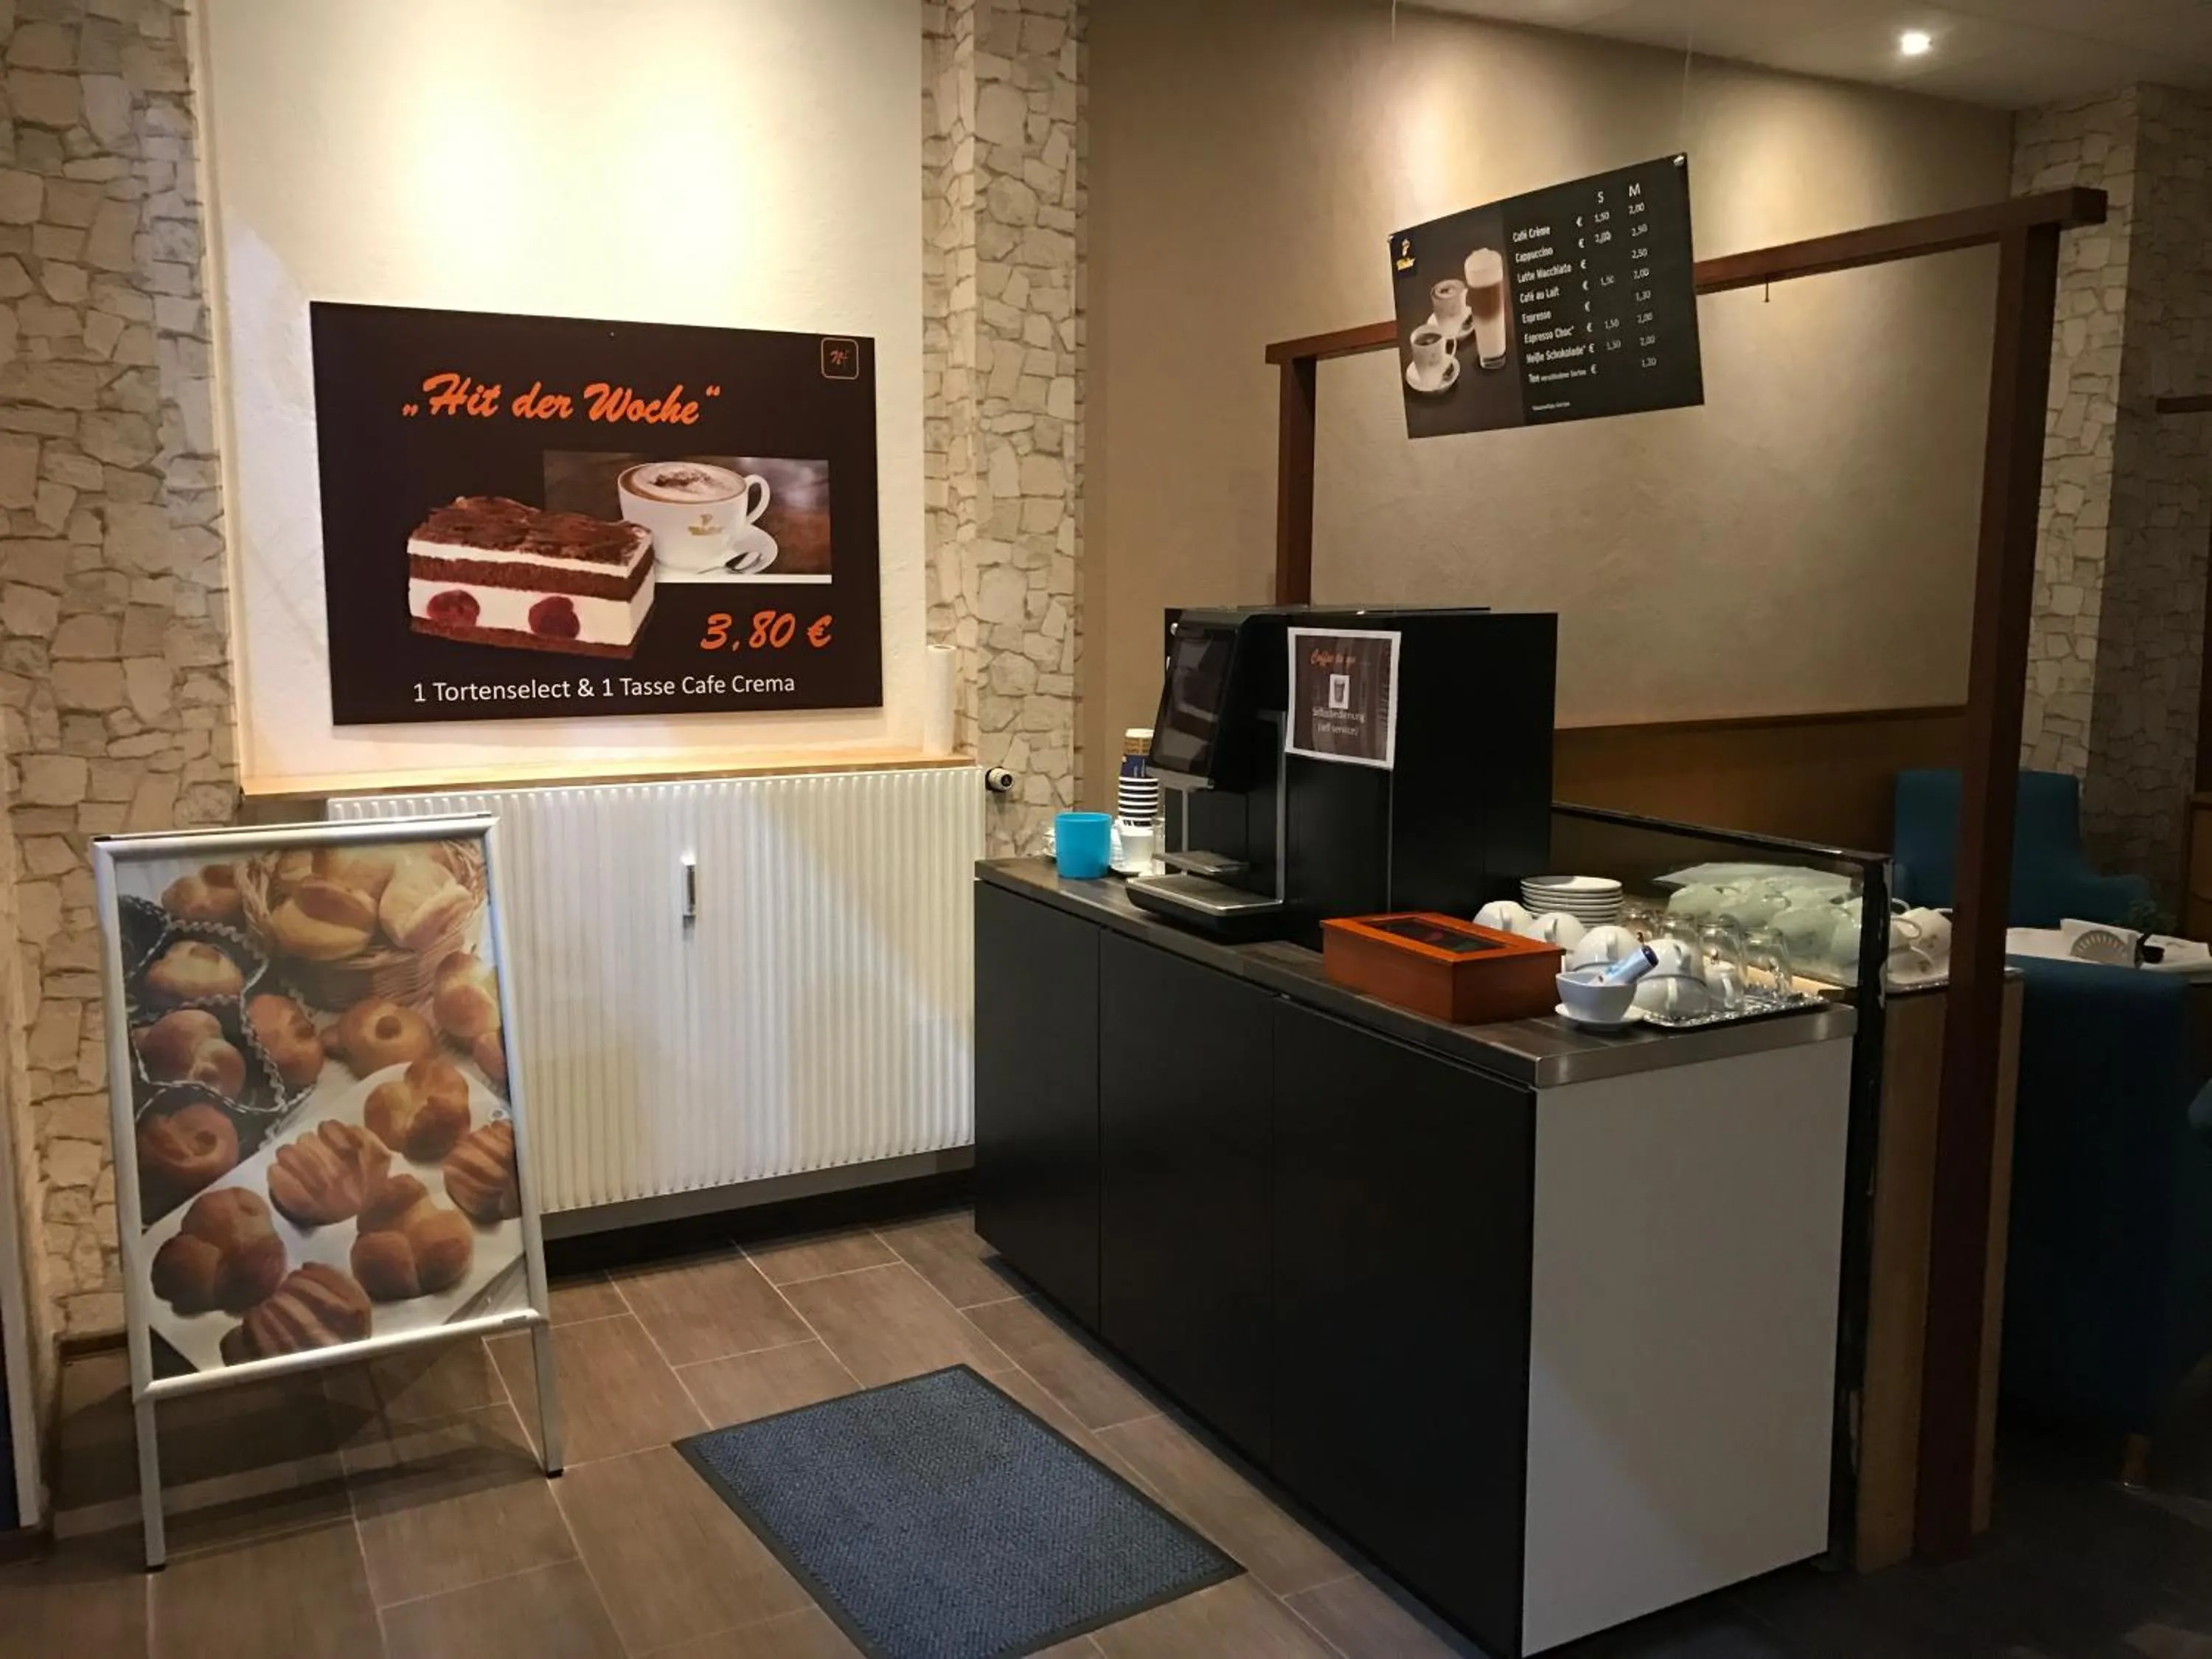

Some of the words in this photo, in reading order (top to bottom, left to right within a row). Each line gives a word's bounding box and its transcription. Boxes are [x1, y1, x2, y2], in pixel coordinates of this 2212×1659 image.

[1597, 190, 1605, 204] S
[1628, 182, 1641, 198] M
[1628, 201, 1645, 215] 2,00
[1515, 246, 1554, 263] Cappuccino
[1517, 271, 1535, 284] Latte
[1631, 248, 1648, 260] 2,50
[1521, 310, 1553, 324] Espresso
[1524, 331, 1554, 344] Espresso
[512, 381, 573, 419] der
[700, 611, 796, 651] 3,80
[807, 615, 833, 650] €
[413, 684, 425, 702] 1
[433, 678, 571, 701] Tortenselect
[577, 678, 594, 698] &
[602, 678, 614, 697] 1
[618, 676, 676, 697] Tasse
[681, 673, 726, 696] Cafe
[731, 675, 796, 694] Crema
